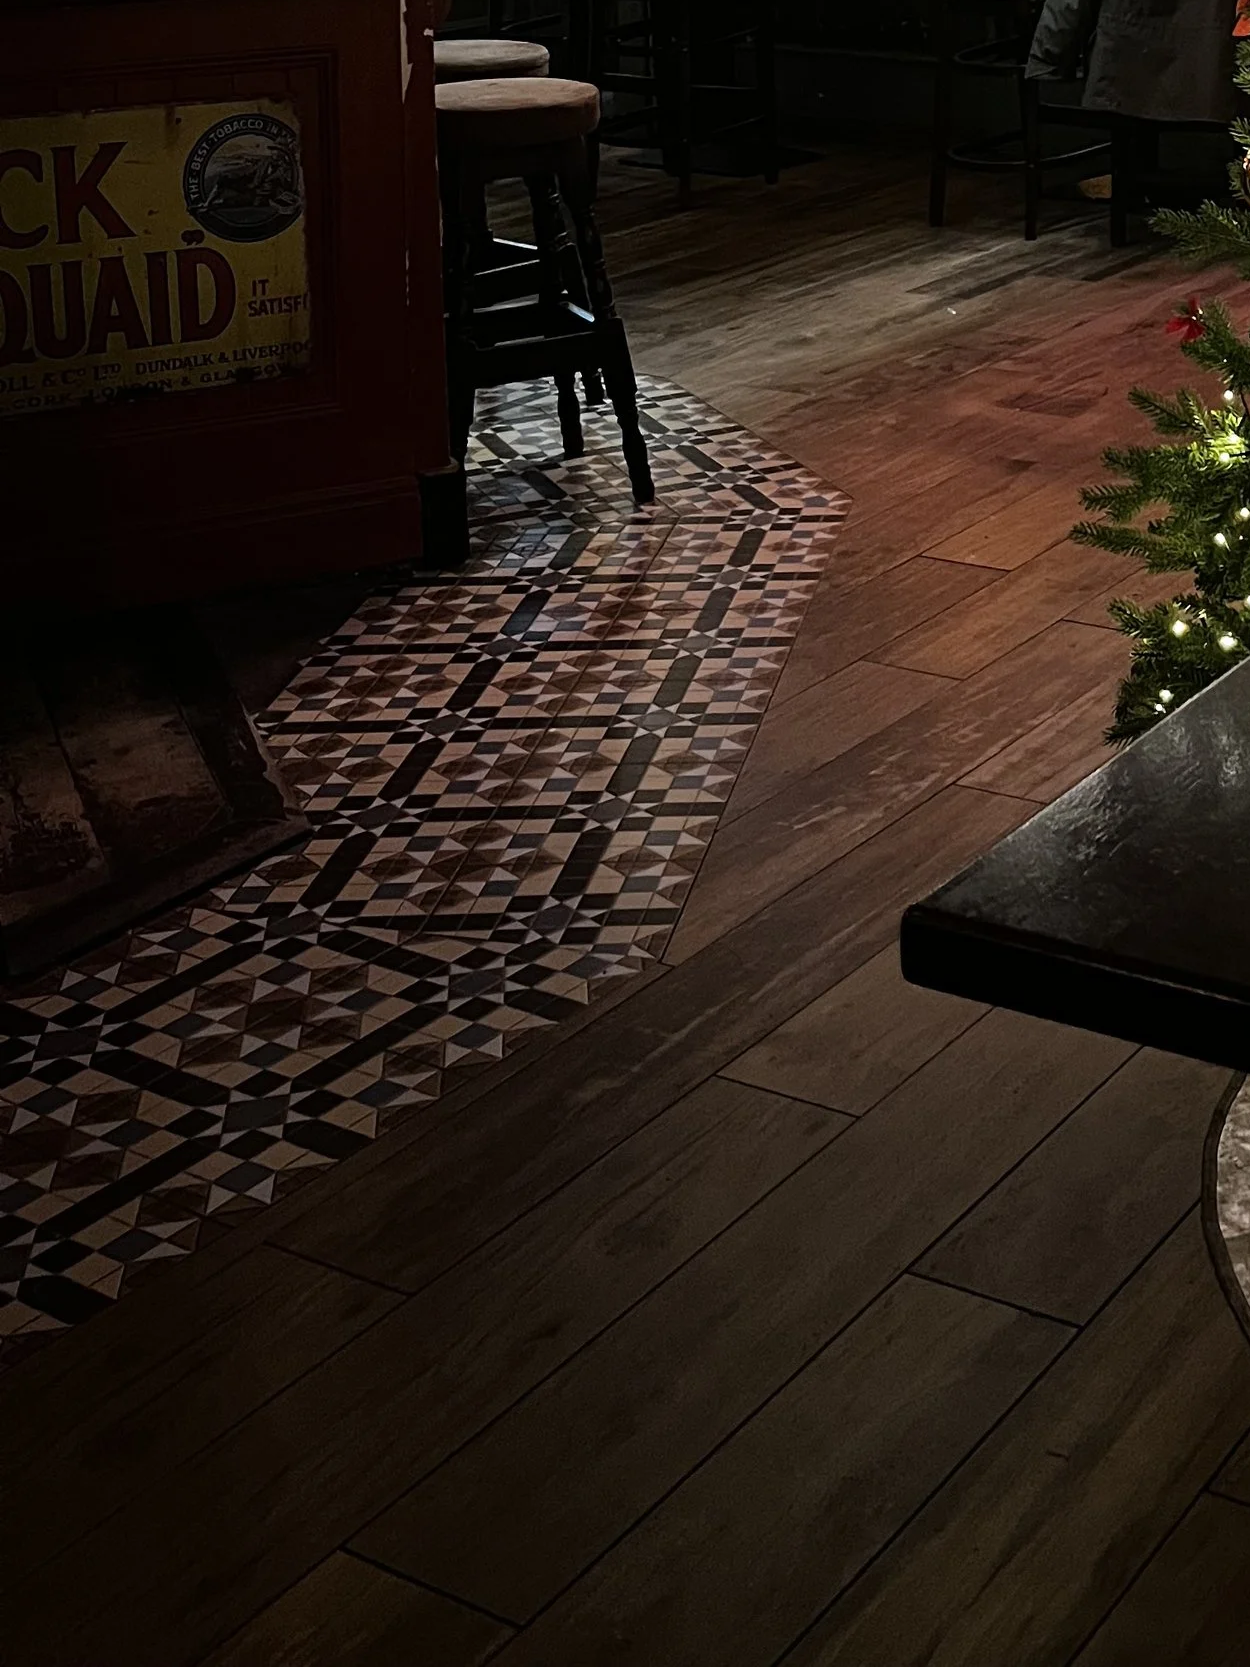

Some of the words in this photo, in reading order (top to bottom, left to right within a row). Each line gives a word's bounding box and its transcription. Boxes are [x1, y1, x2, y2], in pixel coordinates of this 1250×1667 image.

[208, 118, 264, 143] TOBACCO
[190, 142, 211, 171] BEST
[188, 176, 200, 200] THE
[251, 278, 270, 297] IT
[135, 352, 214, 375] DUNDALK
[218, 351, 230, 363] &
